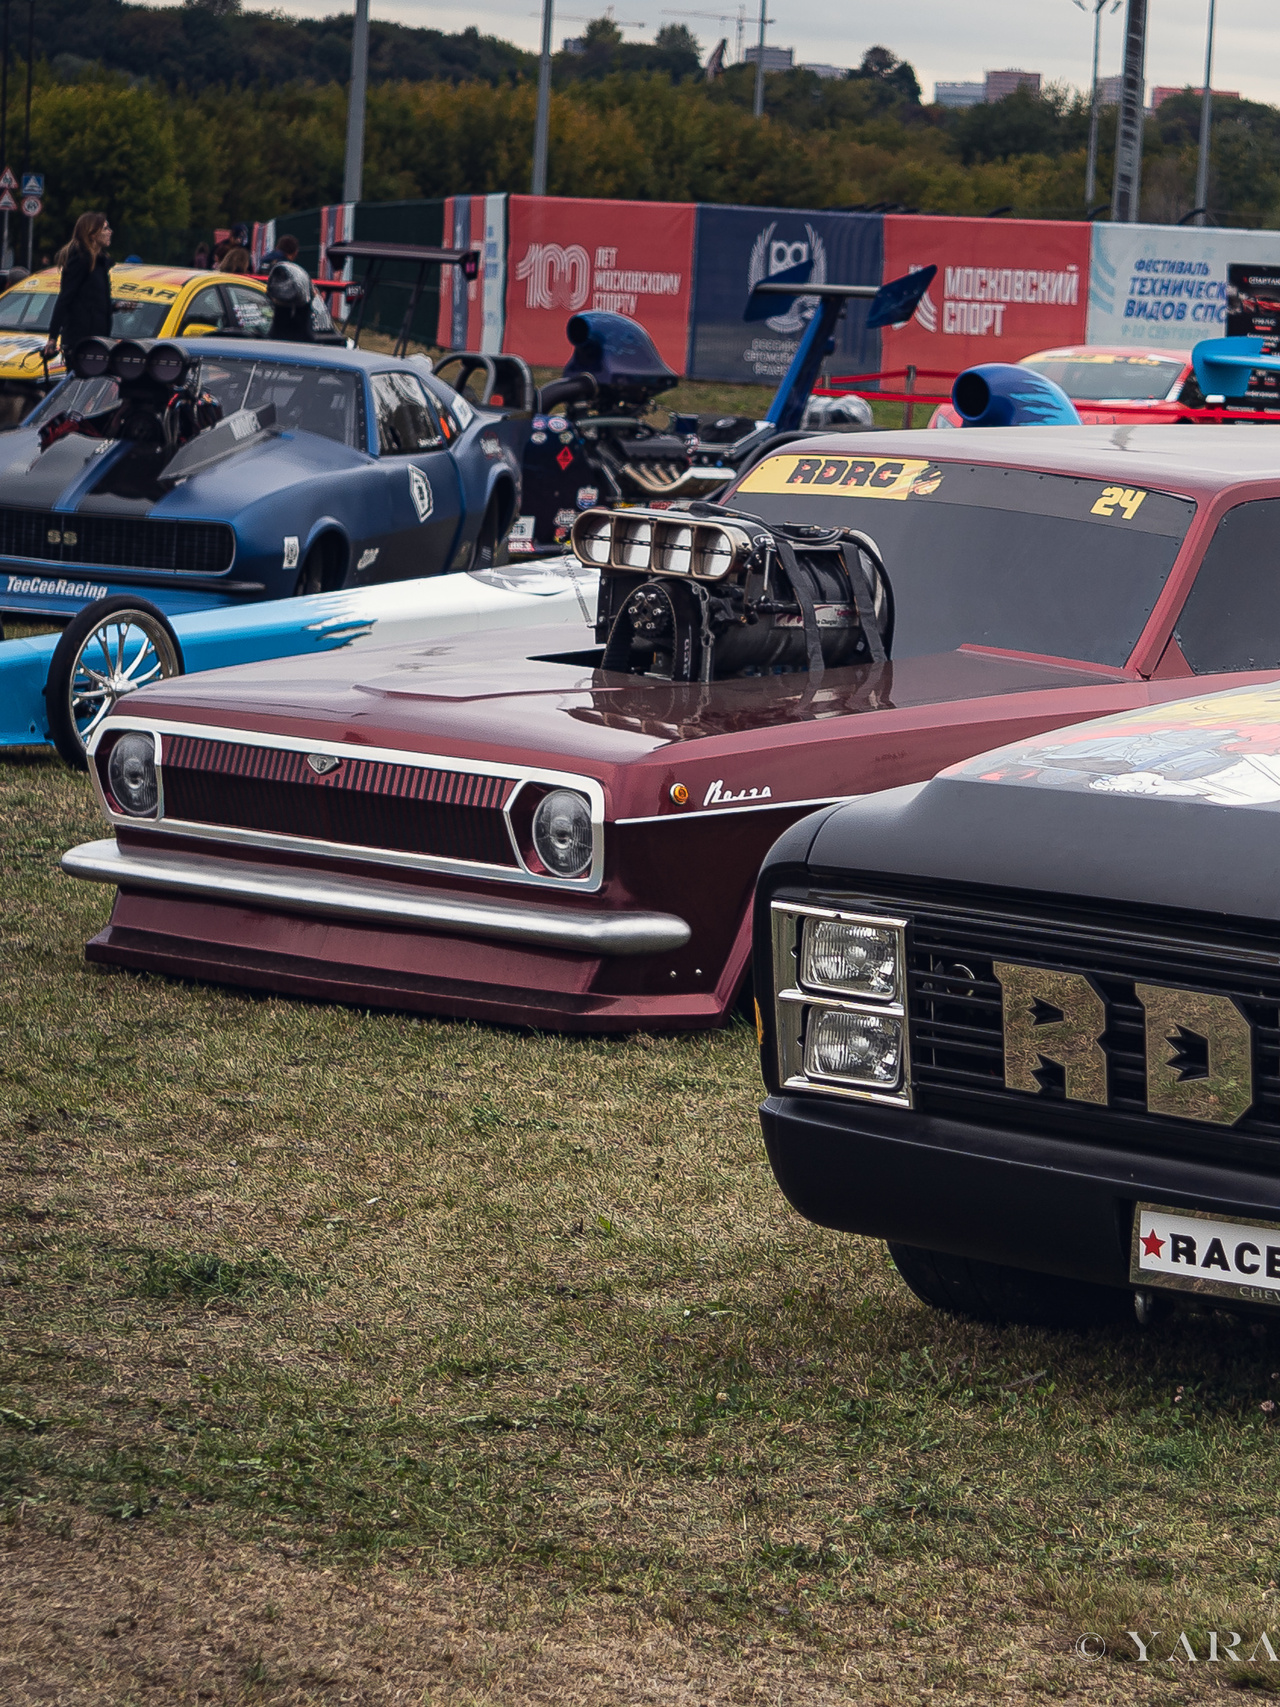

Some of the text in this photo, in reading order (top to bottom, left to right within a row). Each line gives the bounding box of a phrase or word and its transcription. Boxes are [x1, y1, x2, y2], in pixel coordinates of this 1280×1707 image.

[516, 243, 590, 311] 100
[1134, 259, 1210, 276] ФЕСТИВАЛЬ
[944, 263, 1079, 305] МОСКОВСКИЙ
[943, 301, 1006, 337] СПОРТ
[1124, 299, 1187, 321] ВИДОВ
[786, 459, 905, 488] RDRC
[1090, 486, 1147, 520] 24
[7, 575, 108, 601] TeeCeeRacing
